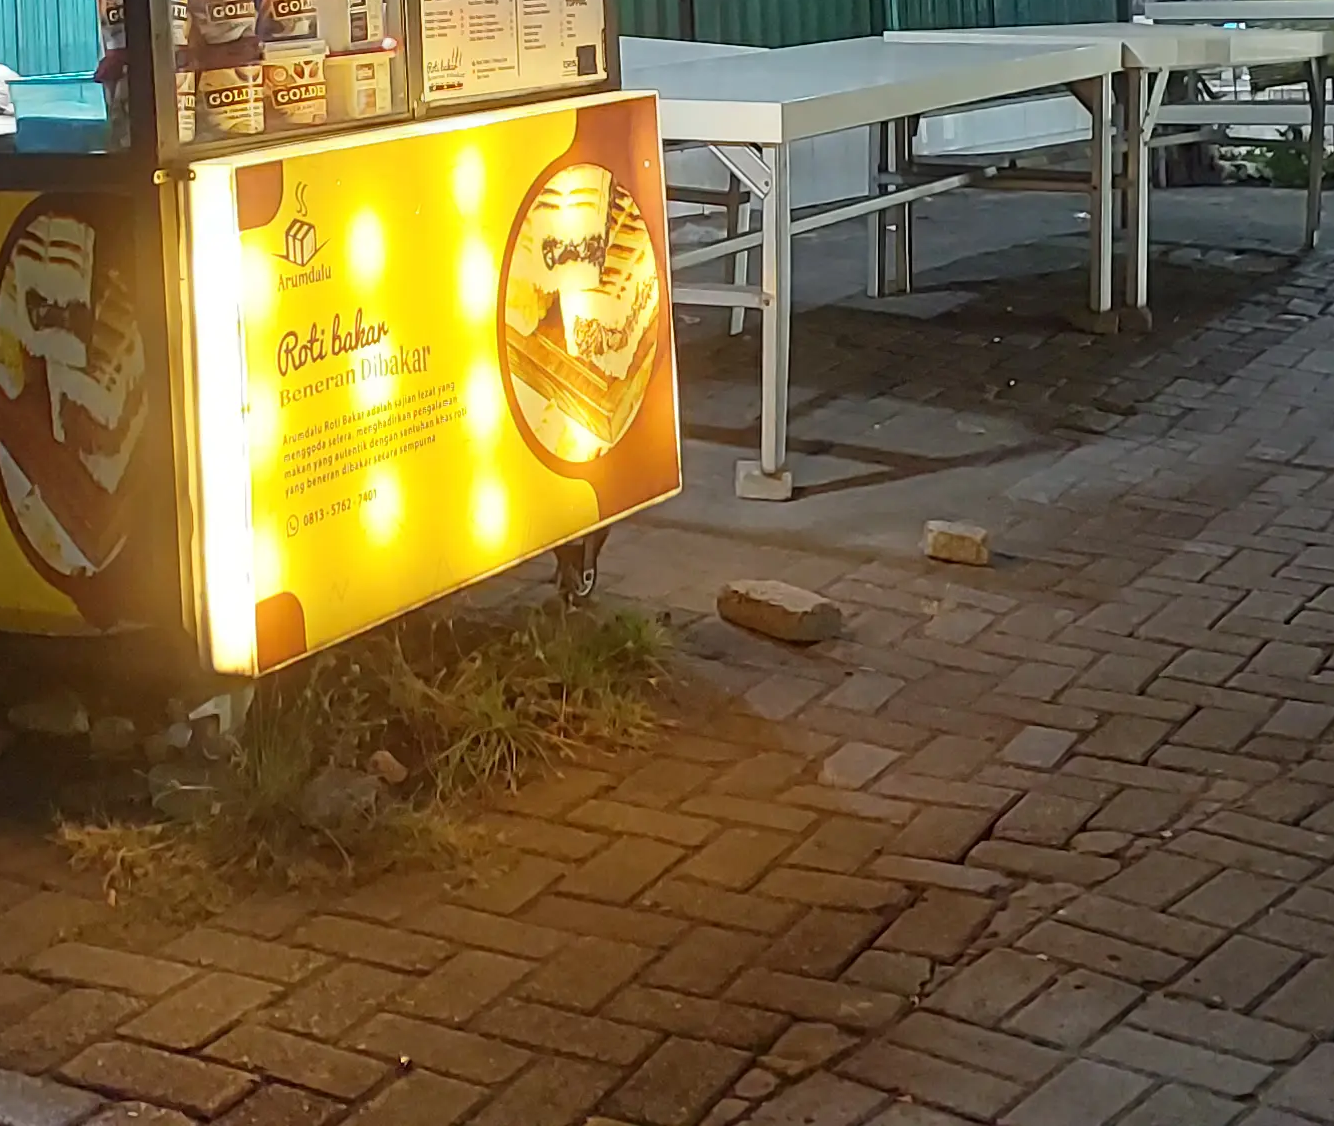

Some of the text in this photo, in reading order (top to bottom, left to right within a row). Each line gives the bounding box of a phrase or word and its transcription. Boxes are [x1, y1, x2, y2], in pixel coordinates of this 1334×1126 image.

[277, 263, 333, 293] Arumdalu
[276, 307, 389, 377] Roti bakar
[279, 344, 432, 409] Beneran Dibakar
[283, 381, 456, 447] Arumdalu Roti Bakar adalah sajian lezat yang
[283, 441, 327, 463] menggoda
[356, 411, 412, 438] menghadirkan
[412, 395, 459, 419] pengalaman
[284, 462, 313, 479] makan
[313, 453, 334, 472] yang
[334, 441, 369, 461] autentik
[369, 431, 399, 450] dengan
[400, 420, 435, 440] sentuhan
[435, 412, 454, 426] khas
[285, 433, 437, 499] yang beneran dibakar secara sempurna
[303, 487, 378, 528] 0813 5762 7401
